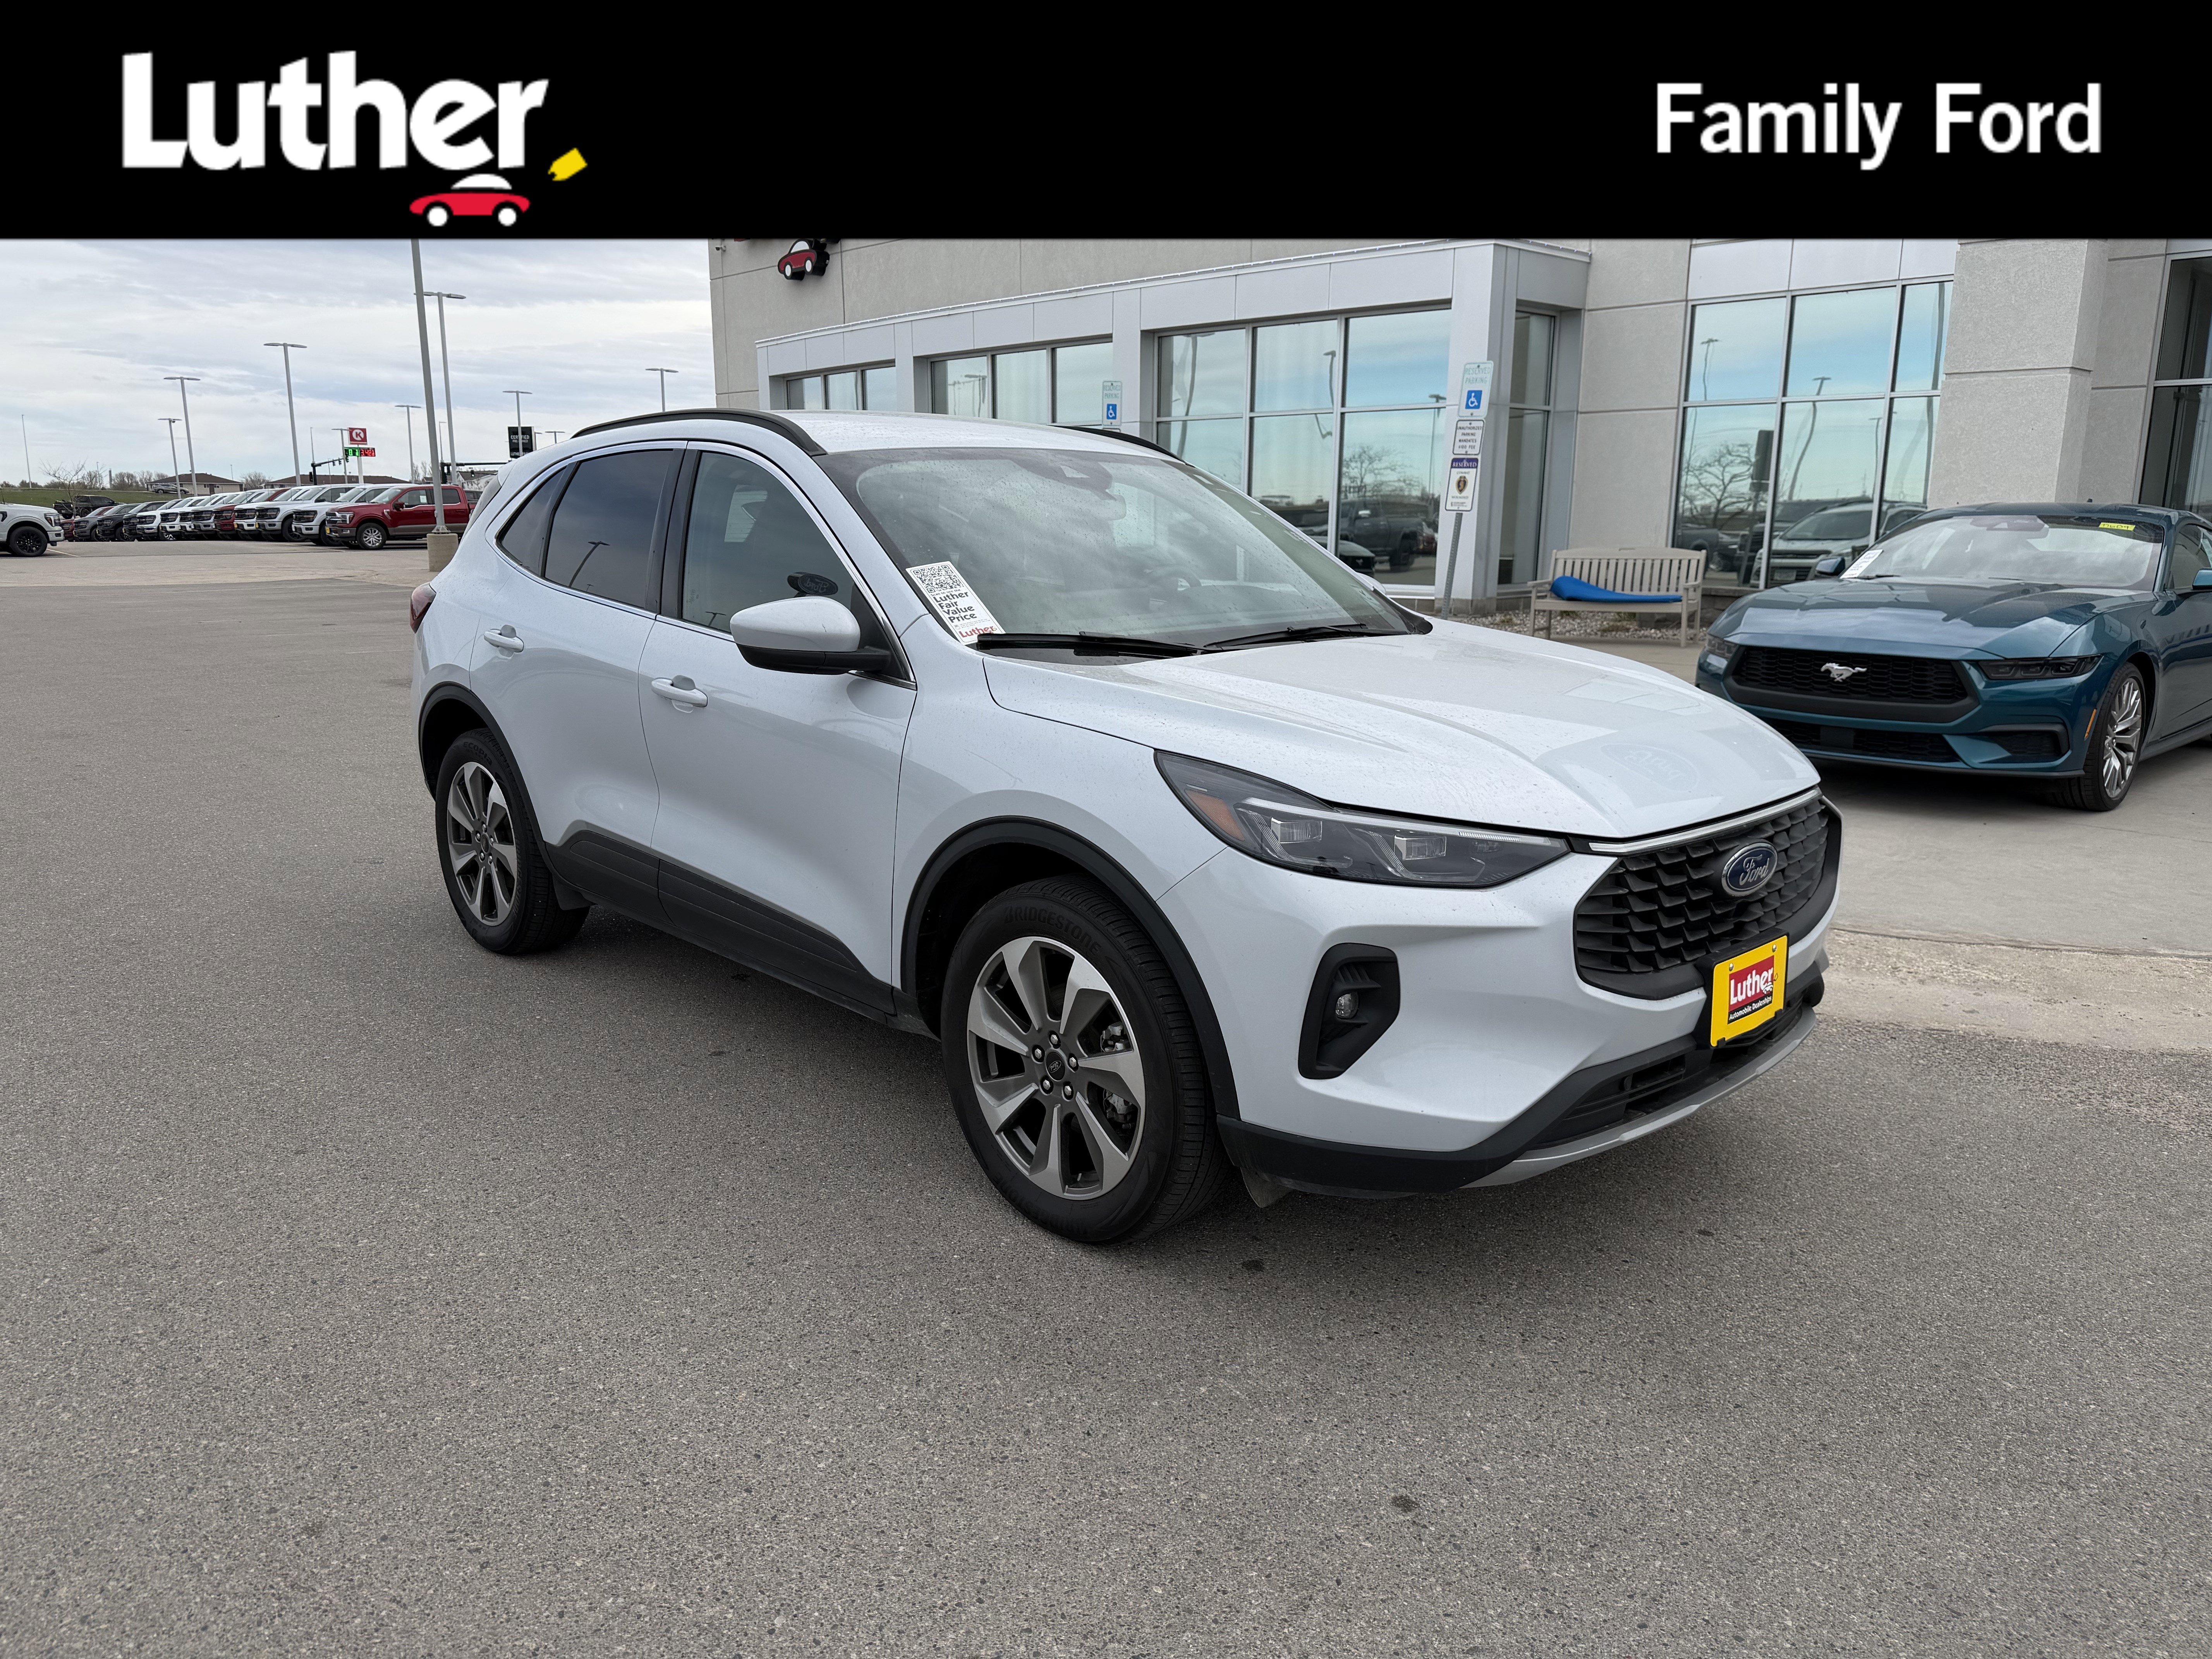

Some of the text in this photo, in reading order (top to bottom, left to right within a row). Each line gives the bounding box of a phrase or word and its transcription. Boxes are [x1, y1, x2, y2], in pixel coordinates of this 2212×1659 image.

[933, 592, 969, 603] Luther
[938, 601, 958, 610] Fair
[942, 606, 975, 615] Value
[948, 613, 977, 623] Price
[958, 626, 994, 638] Luther
[1739, 854, 1770, 886] Ford
[1003, 905, 1102, 956] BRIDGESTONE
[1730, 967, 1774, 1005] Luther
[1729, 1005, 1752, 1021] Automobile
